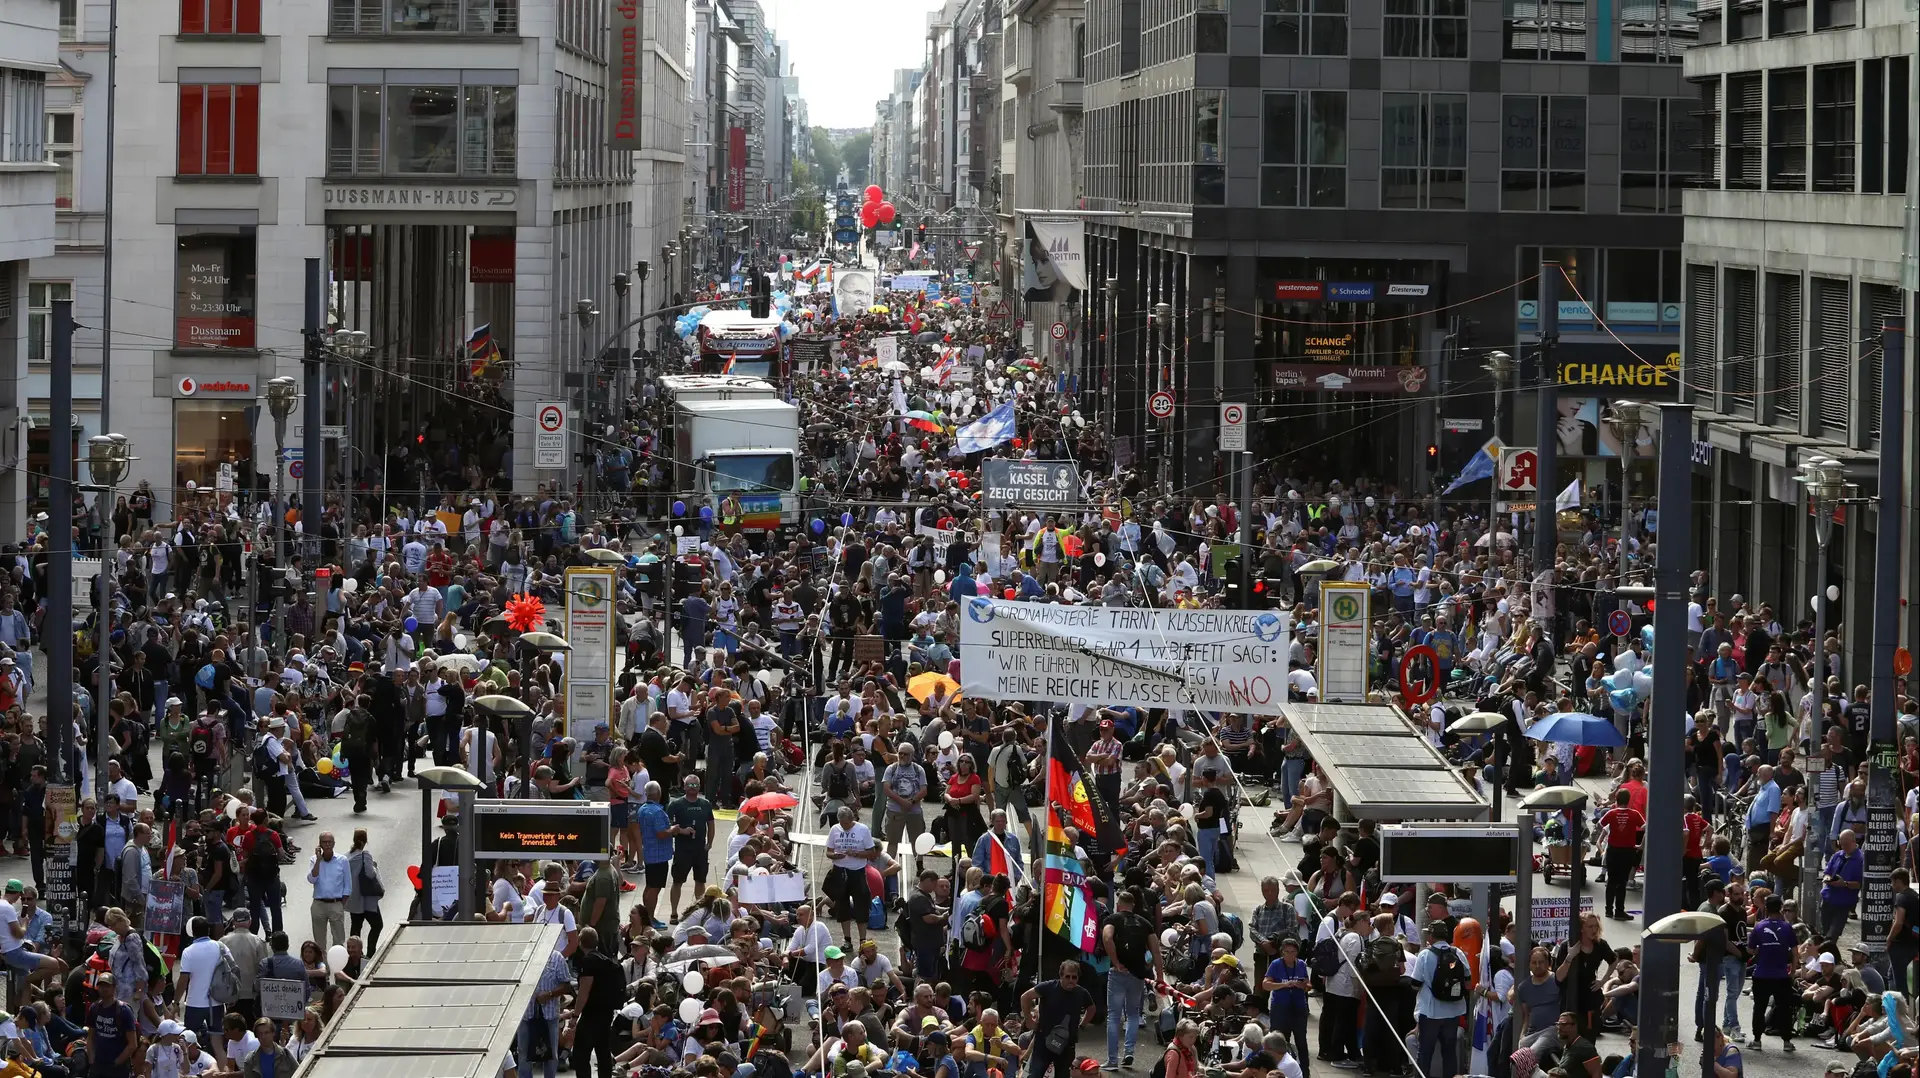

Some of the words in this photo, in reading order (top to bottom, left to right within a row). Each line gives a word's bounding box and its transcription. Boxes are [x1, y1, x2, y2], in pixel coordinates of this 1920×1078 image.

[616, 26, 637, 139] Dussmann
[324, 189, 480, 204] DUSSMANN-HAUS
[472, 266, 513, 276] Dussmann
[214, 276, 230, 284] Uhr
[1391, 286, 1425, 294] Diesterweg
[190, 292, 201, 300] Sa
[226, 304, 242, 312] Uhr
[190, 326, 241, 336] Dussmann
[1054, 327, 1064, 336] 30
[1276, 370, 1298, 378] berlin
[1348, 368, 1386, 378] Mmmh!
[200, 381, 250, 392] vodafone
[1276, 377, 1298, 386] tapas
[1154, 399, 1169, 410] 30
[1009, 472, 1049, 486] KASSEL
[988, 487, 1020, 500] ZEIGT
[1023, 488, 1070, 501] GESICHT
[1110, 610, 1160, 630] TARNT
[991, 630, 1086, 654] SUPERREICHER
[1034, 654, 1080, 674] FÜHREN
[1108, 680, 1170, 703] KLASSE
[1229, 676, 1272, 706] NO
[1856, 715, 1864, 730] 2
[1868, 822, 1895, 830] BLEIBEN
[517, 832, 556, 841] Tramverkehr
[1062, 872, 1088, 888] PAIX
[1868, 883, 1891, 891] RUHIG
[1866, 892, 1893, 900] BLEIBEN
[262, 983, 280, 992] Selbst
[282, 984, 302, 994] denken
